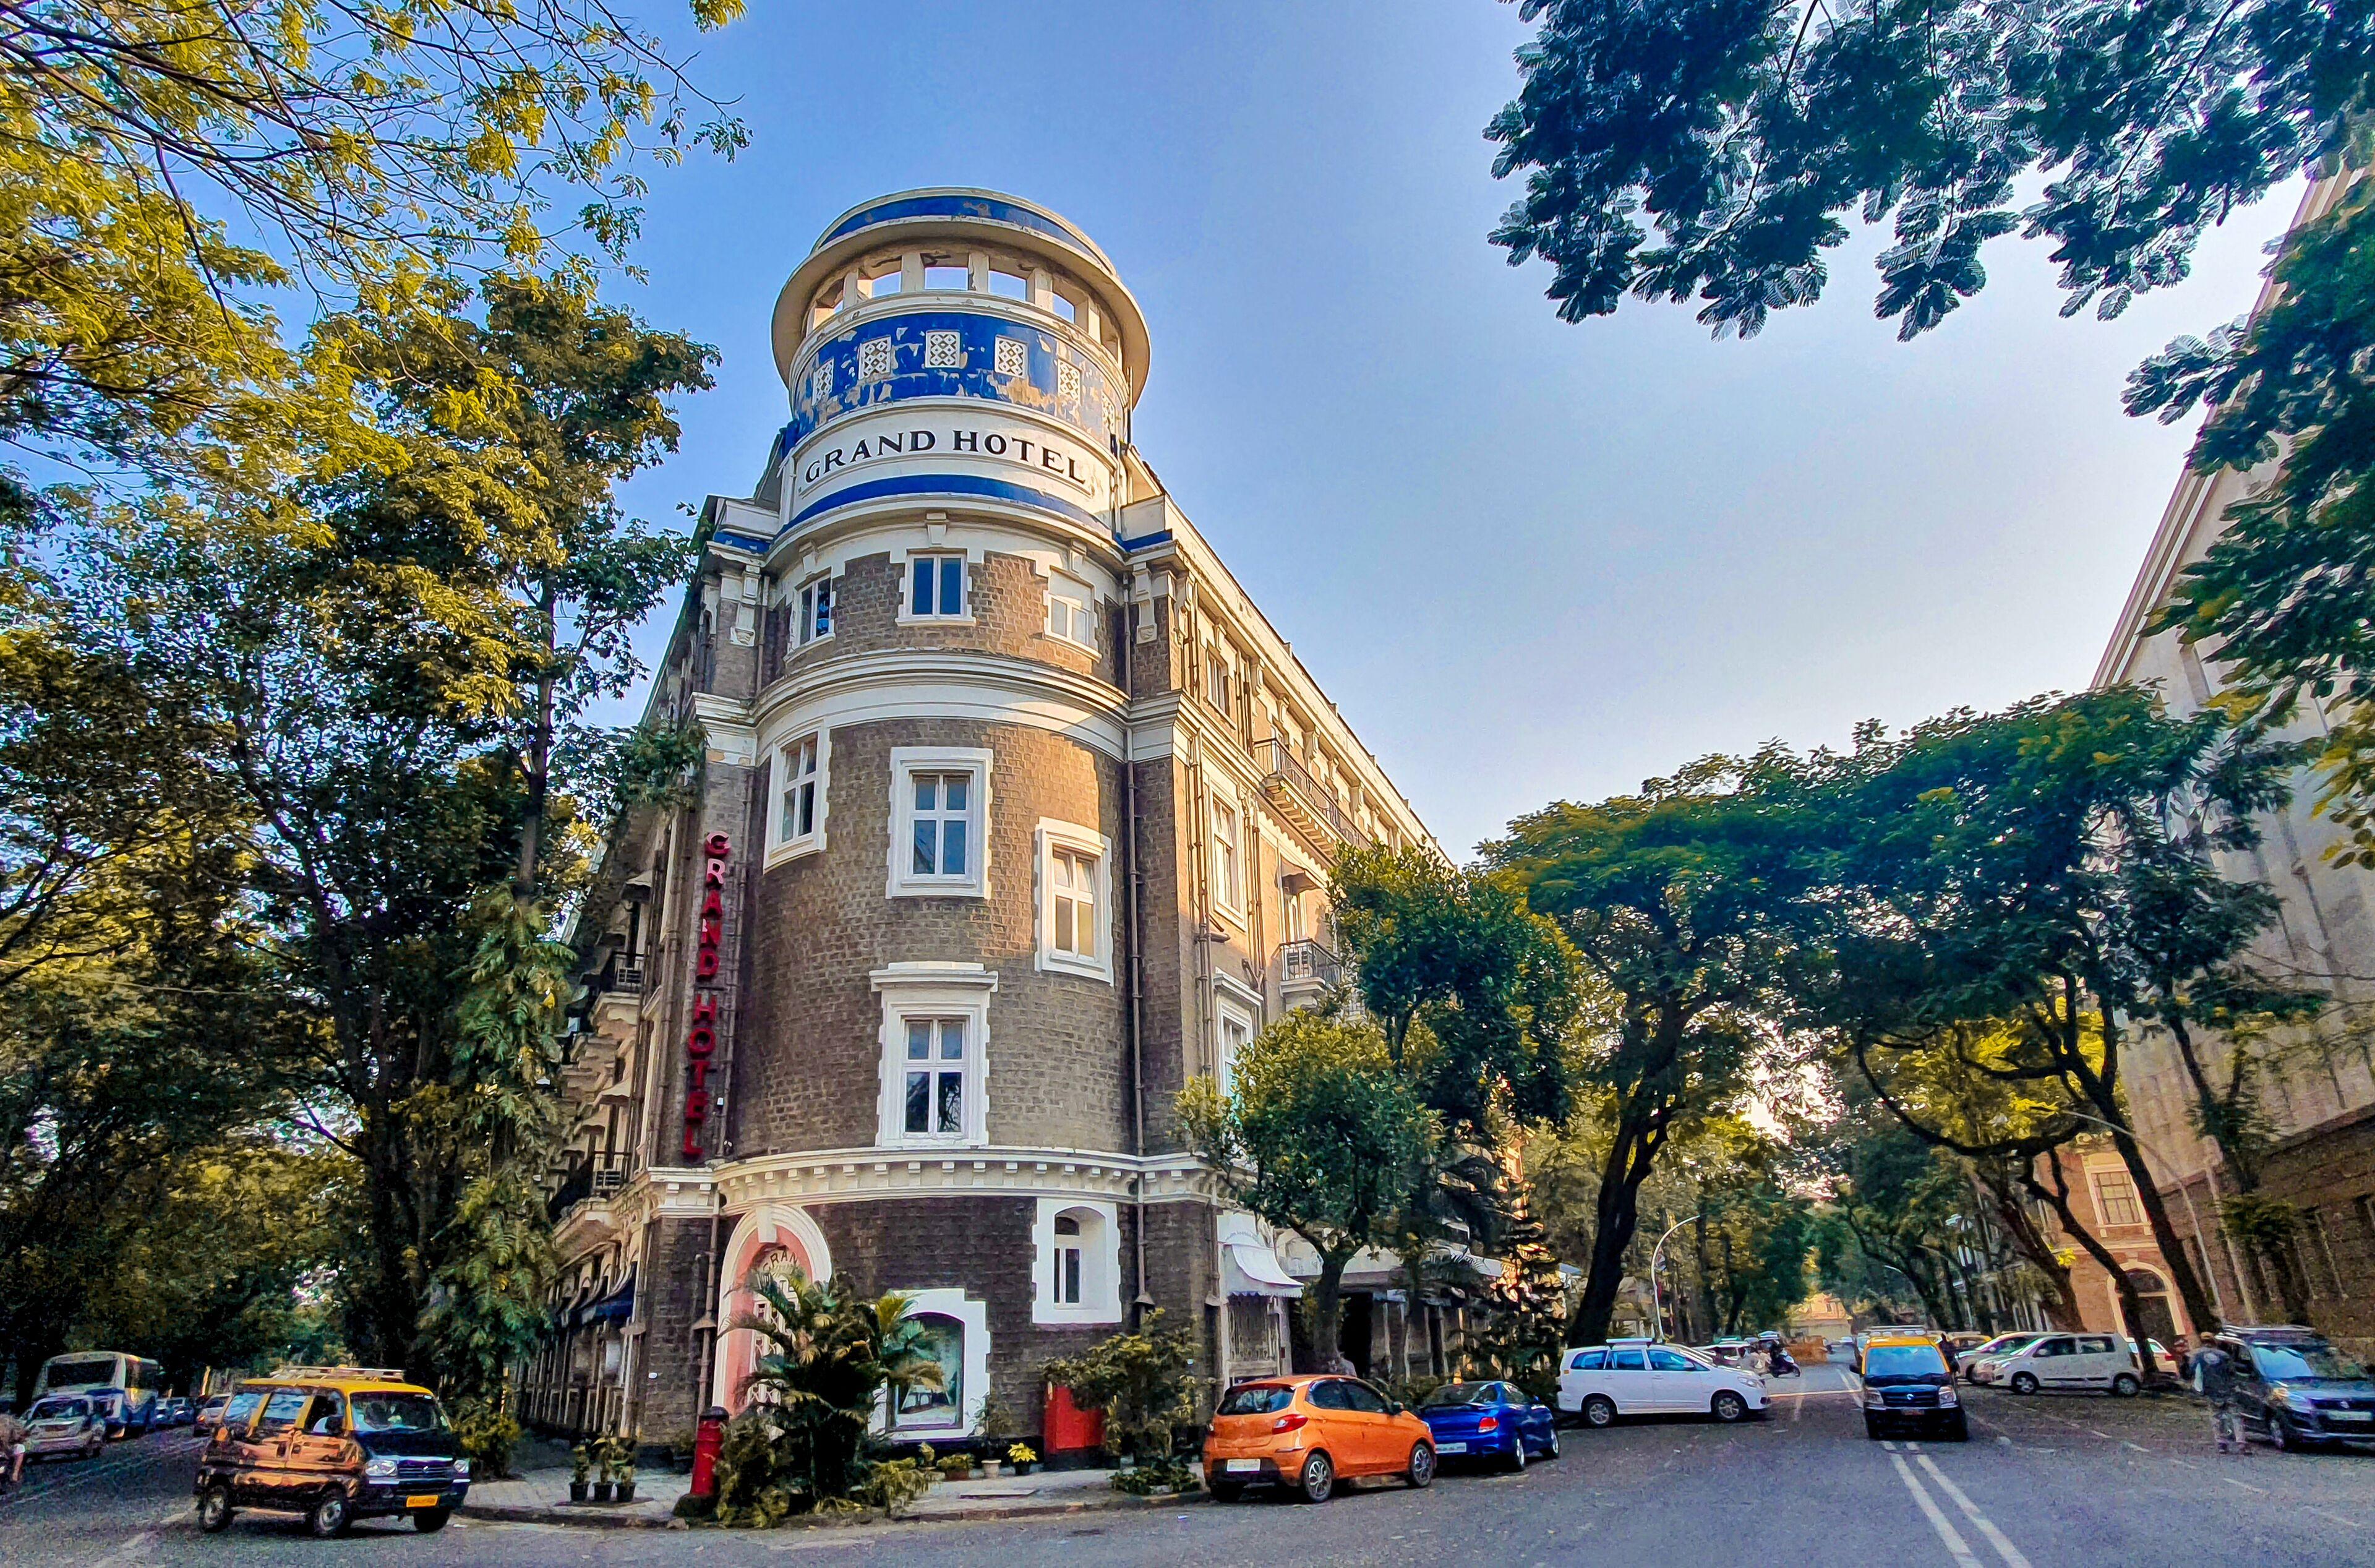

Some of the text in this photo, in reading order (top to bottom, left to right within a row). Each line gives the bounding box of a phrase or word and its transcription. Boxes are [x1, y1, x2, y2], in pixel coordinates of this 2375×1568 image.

[805, 430, 1085, 484] GRAND HOTEL
[682, 831, 730, 1159] GRAND HOTEL
[763, 1250, 799, 1272] GRAN
